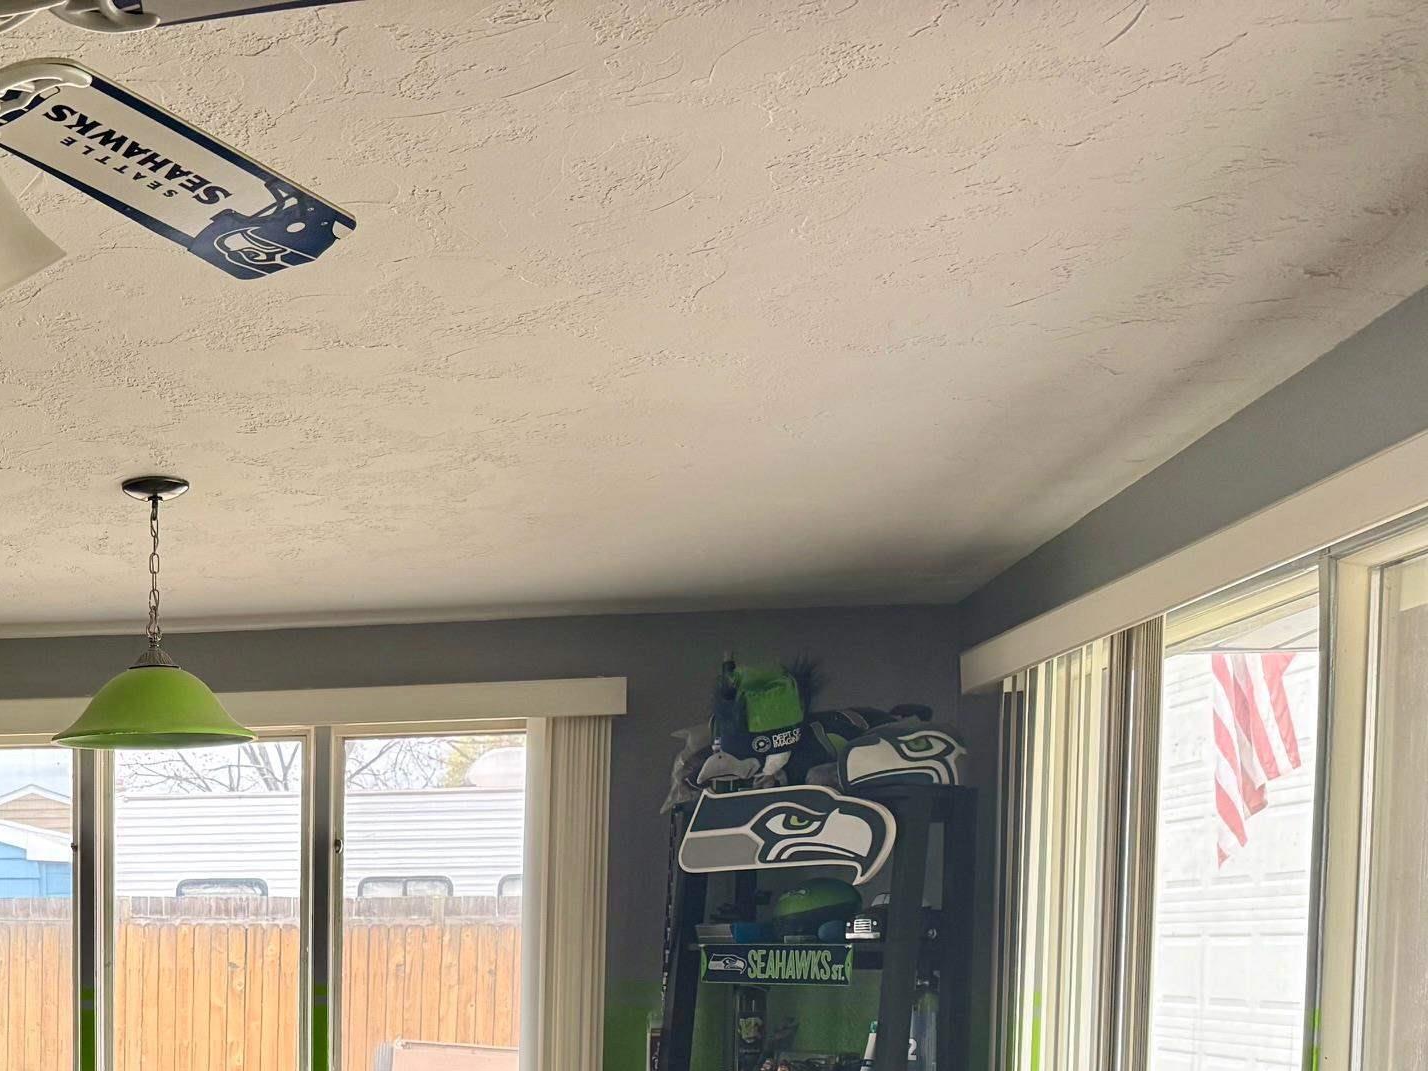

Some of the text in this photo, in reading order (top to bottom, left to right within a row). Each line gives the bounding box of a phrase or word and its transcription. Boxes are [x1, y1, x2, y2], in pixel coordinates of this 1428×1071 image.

[42, 104, 233, 205] SEAHAWKS
[60, 136, 179, 198] SEATTLE
[747, 949, 844, 981] SEAHAWKS ST.
